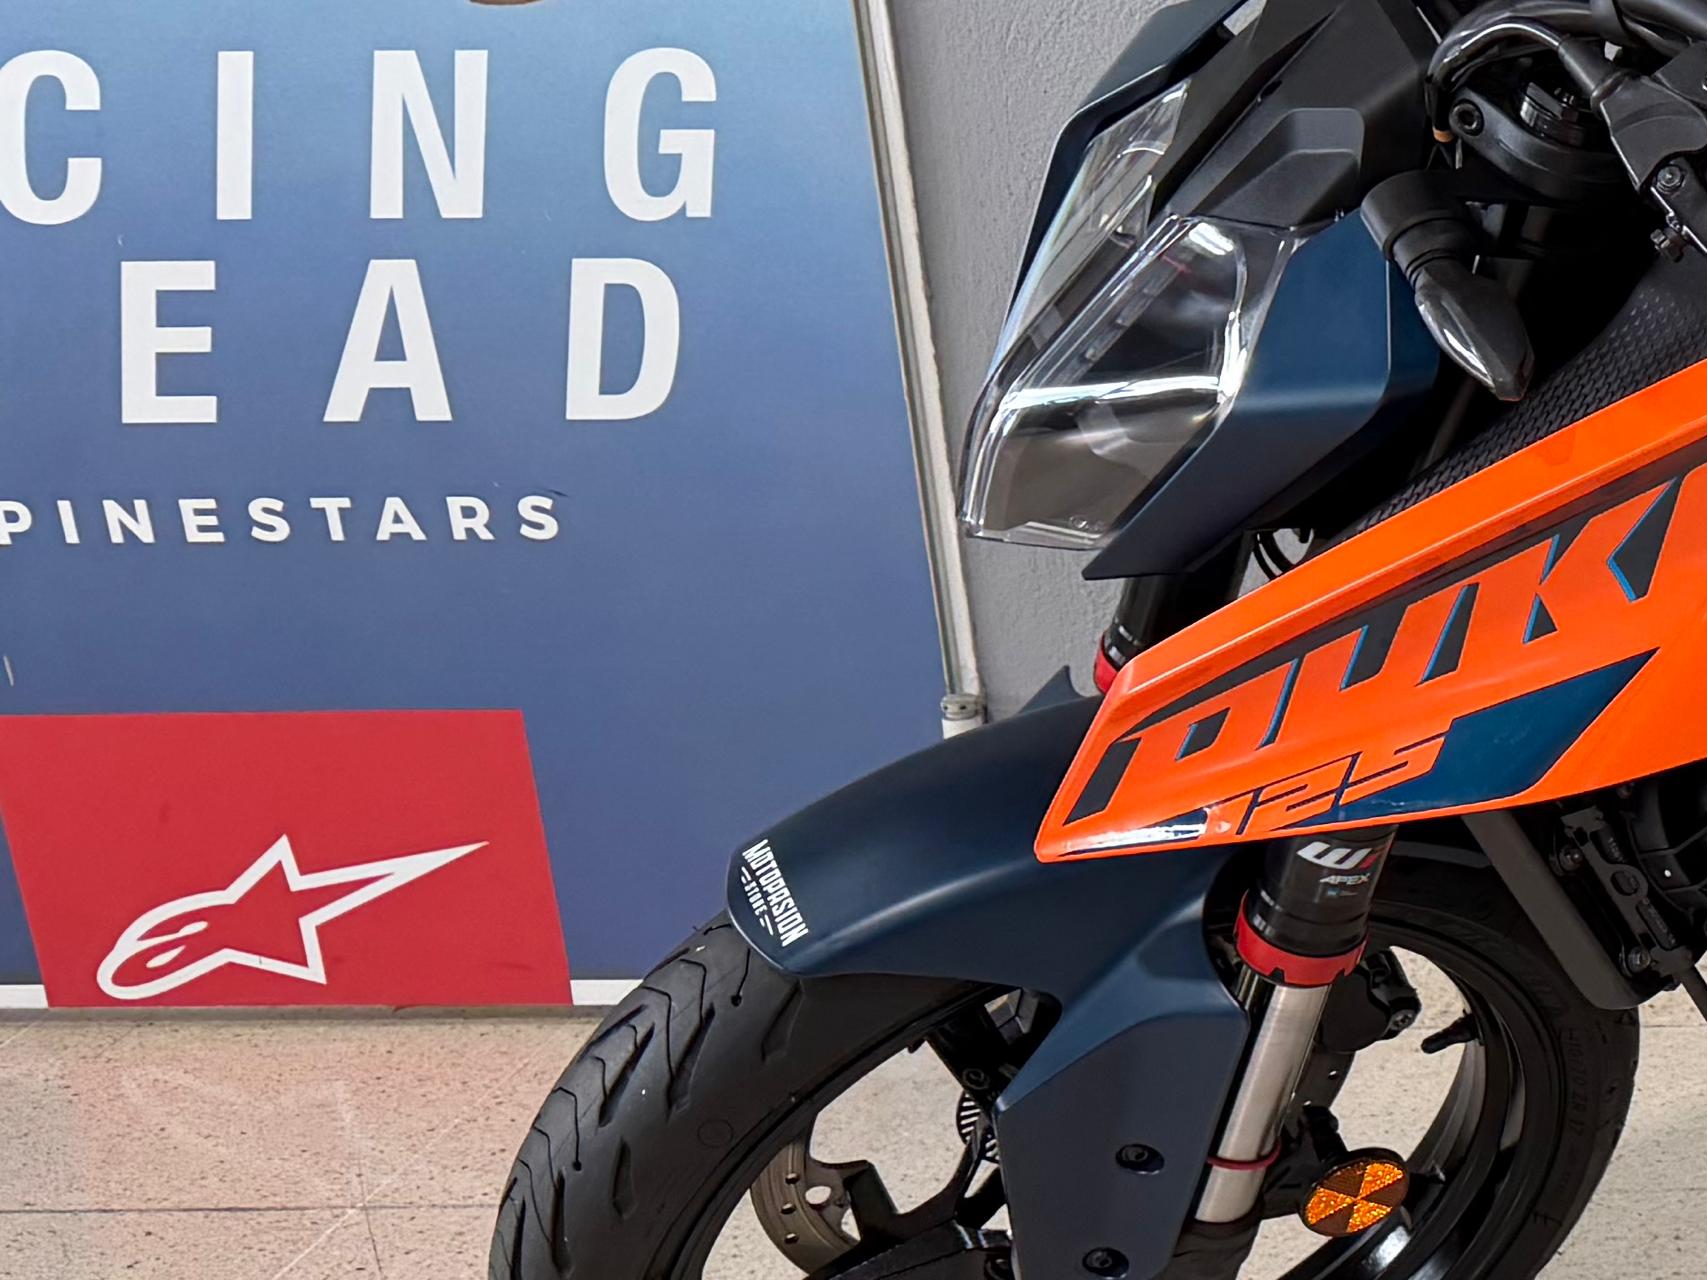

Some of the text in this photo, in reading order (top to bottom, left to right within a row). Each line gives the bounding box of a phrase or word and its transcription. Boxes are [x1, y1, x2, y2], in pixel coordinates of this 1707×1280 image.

[0, 47, 718, 225] CING
[120, 257, 682, 424] EAD
[0, 495, 560, 545] PINESTARS
[1200, 729, 1450, 837] 125
[742, 839, 809, 947] MOTOPASION
[744, 881, 768, 916] STORE
